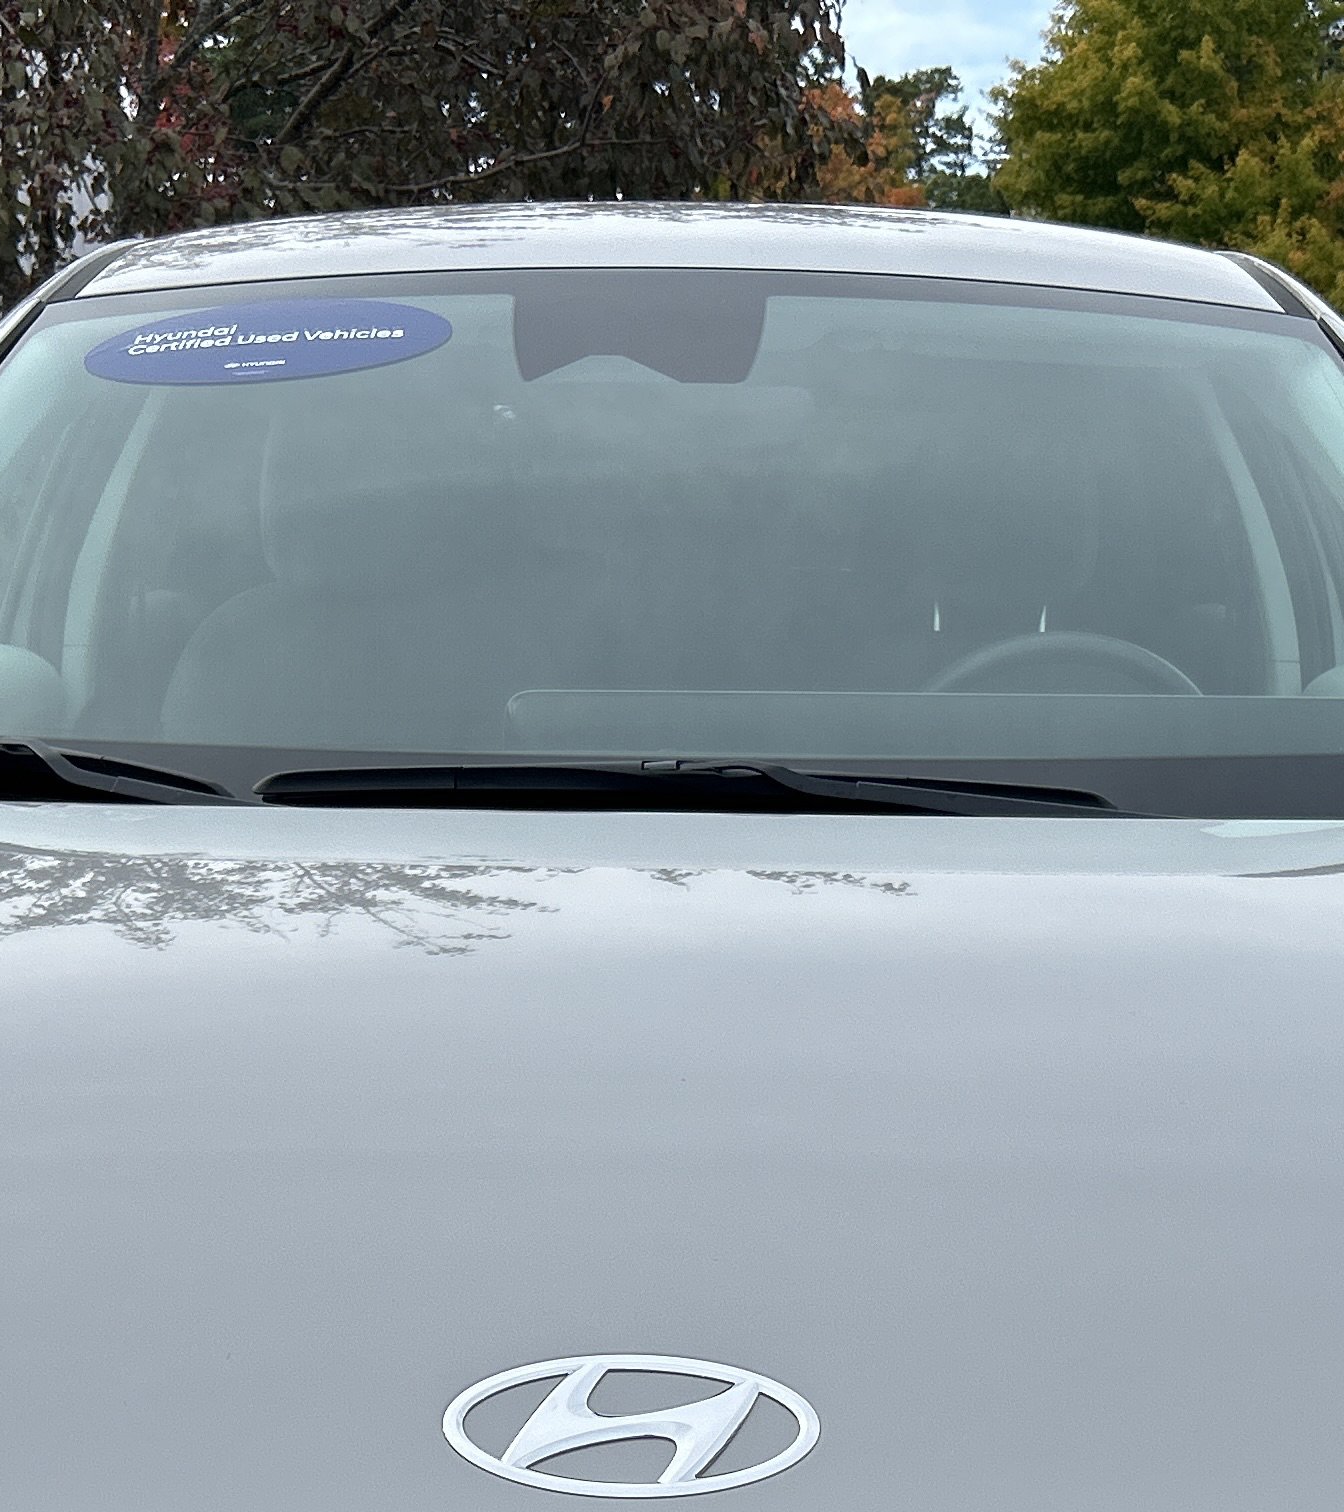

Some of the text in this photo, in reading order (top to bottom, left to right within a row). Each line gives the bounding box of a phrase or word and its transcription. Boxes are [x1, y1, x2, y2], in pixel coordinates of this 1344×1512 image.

[127, 327, 404, 356] Certified Used Vehicles
[134, 323, 238, 345] Hyundai
